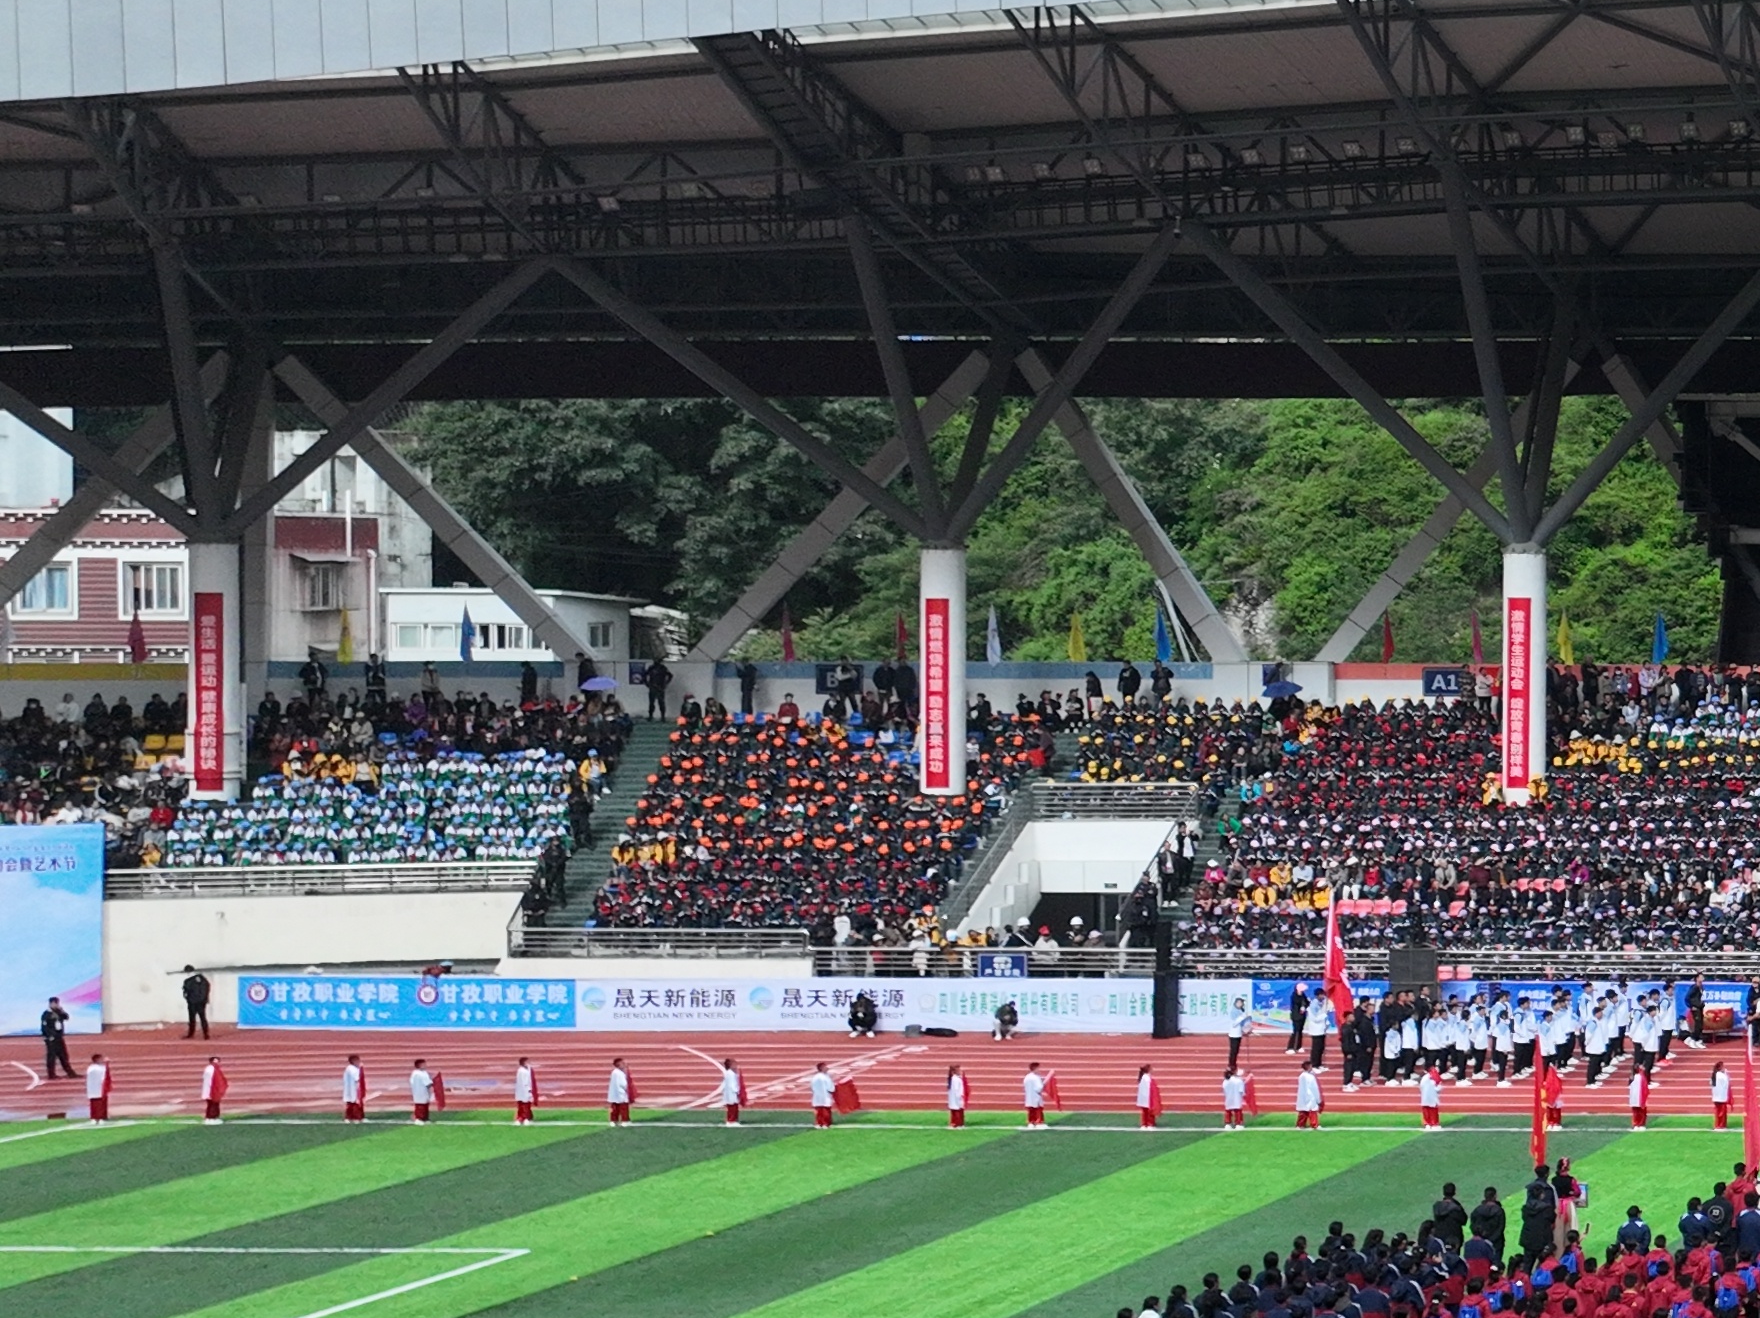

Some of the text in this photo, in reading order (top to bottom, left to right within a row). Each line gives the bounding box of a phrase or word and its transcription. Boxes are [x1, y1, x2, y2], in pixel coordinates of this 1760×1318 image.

[1431, 674, 1458, 690] A1
[0, 855, 76, 872] 会暨艺术节
[272, 983, 399, 1004] 甘孜职业学院
[441, 983, 568, 1005] 甘孜职业学院
[613, 988, 737, 1008] 晟天新能源
